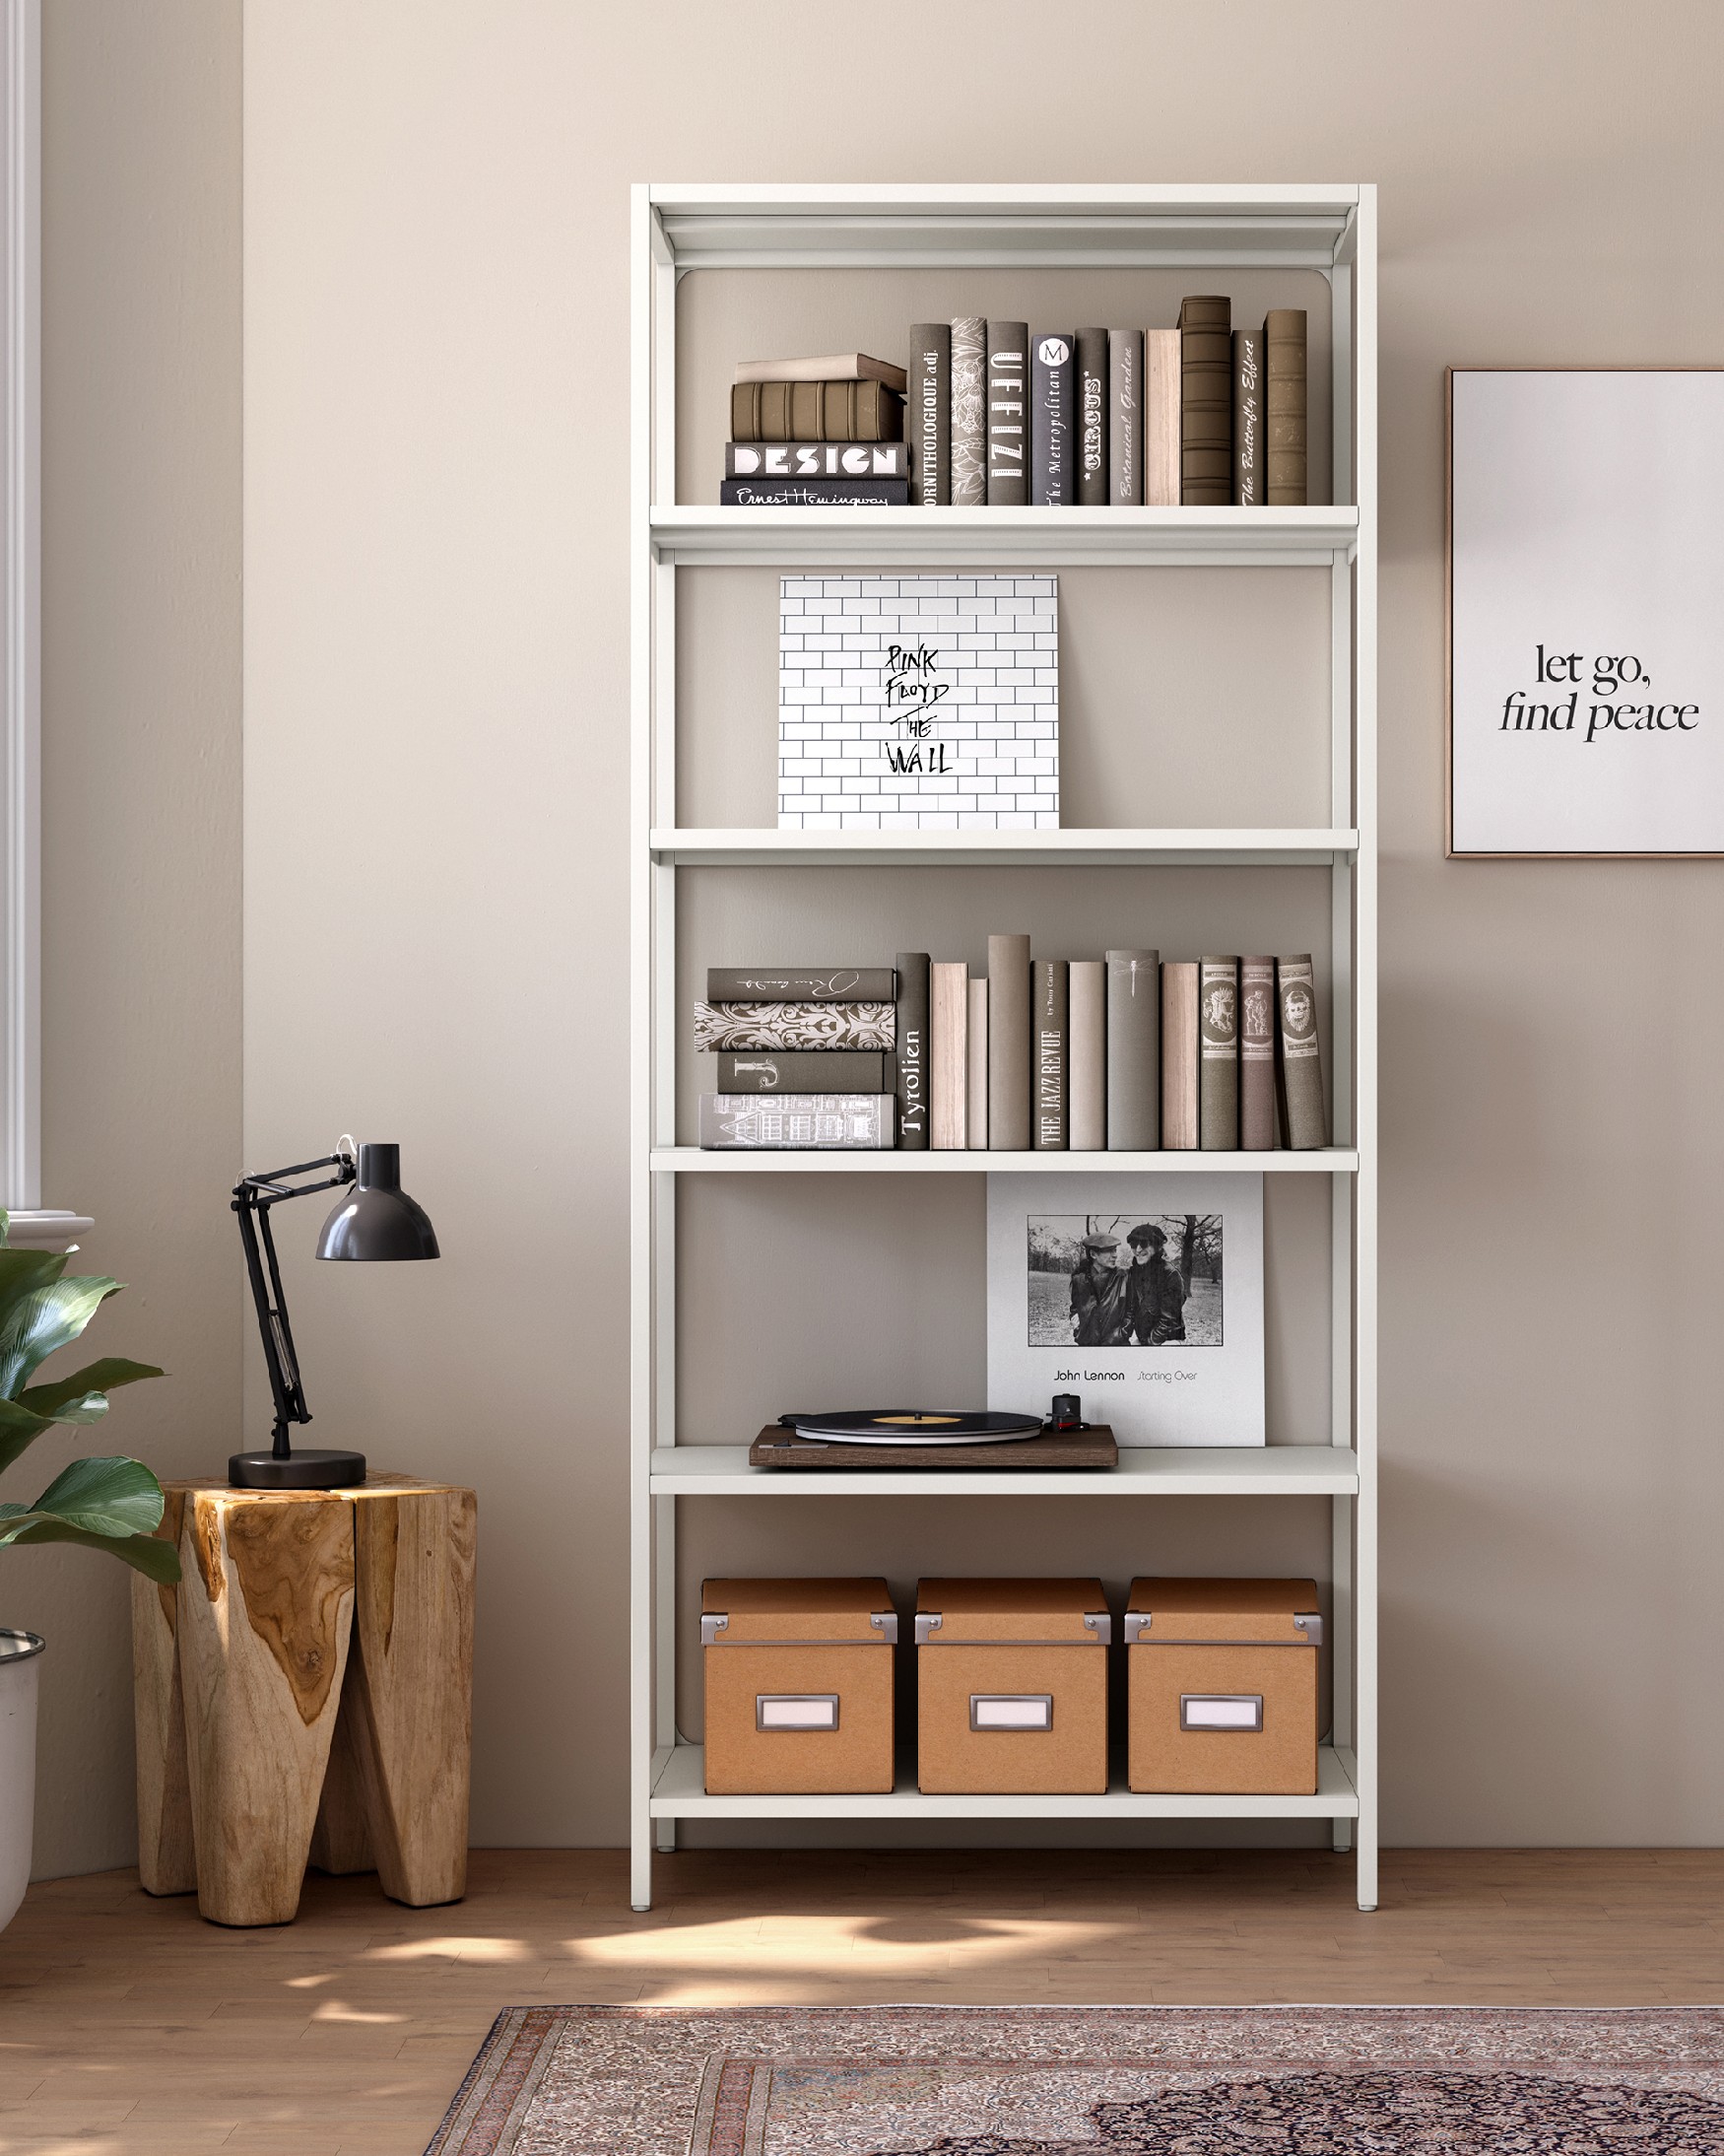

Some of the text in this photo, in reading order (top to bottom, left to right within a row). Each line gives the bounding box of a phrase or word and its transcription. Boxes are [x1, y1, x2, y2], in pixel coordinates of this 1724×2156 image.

[1045, 344, 1063, 361] M
[923, 350, 939, 505] ORNITHOLOGIQUE adj.
[990, 352, 1024, 478] UFFIZI
[1044, 370, 1067, 474] Metropolitan
[1084, 377, 1101, 471] CIRCUS
[1119, 347, 1137, 498] Botanical Garden
[1241, 339, 1258, 505] The Butterfly Effect
[734, 446, 899, 475] DESIGN
[736, 487, 890, 505] Ernest Hemingway
[885, 642, 939, 678] PINK
[1535, 643, 1651, 697] let go,
[885, 671, 950, 708] FLOYD
[890, 705, 938, 740] THE
[1497, 691, 1700, 743] find peace
[885, 741, 954, 774] WALL
[901, 1030, 926, 1136] Tyrolien
[1040, 1030, 1061, 1145] THE JAZZ REVUE
[1053, 1370, 1198, 1383] John Lennon Starting Over
